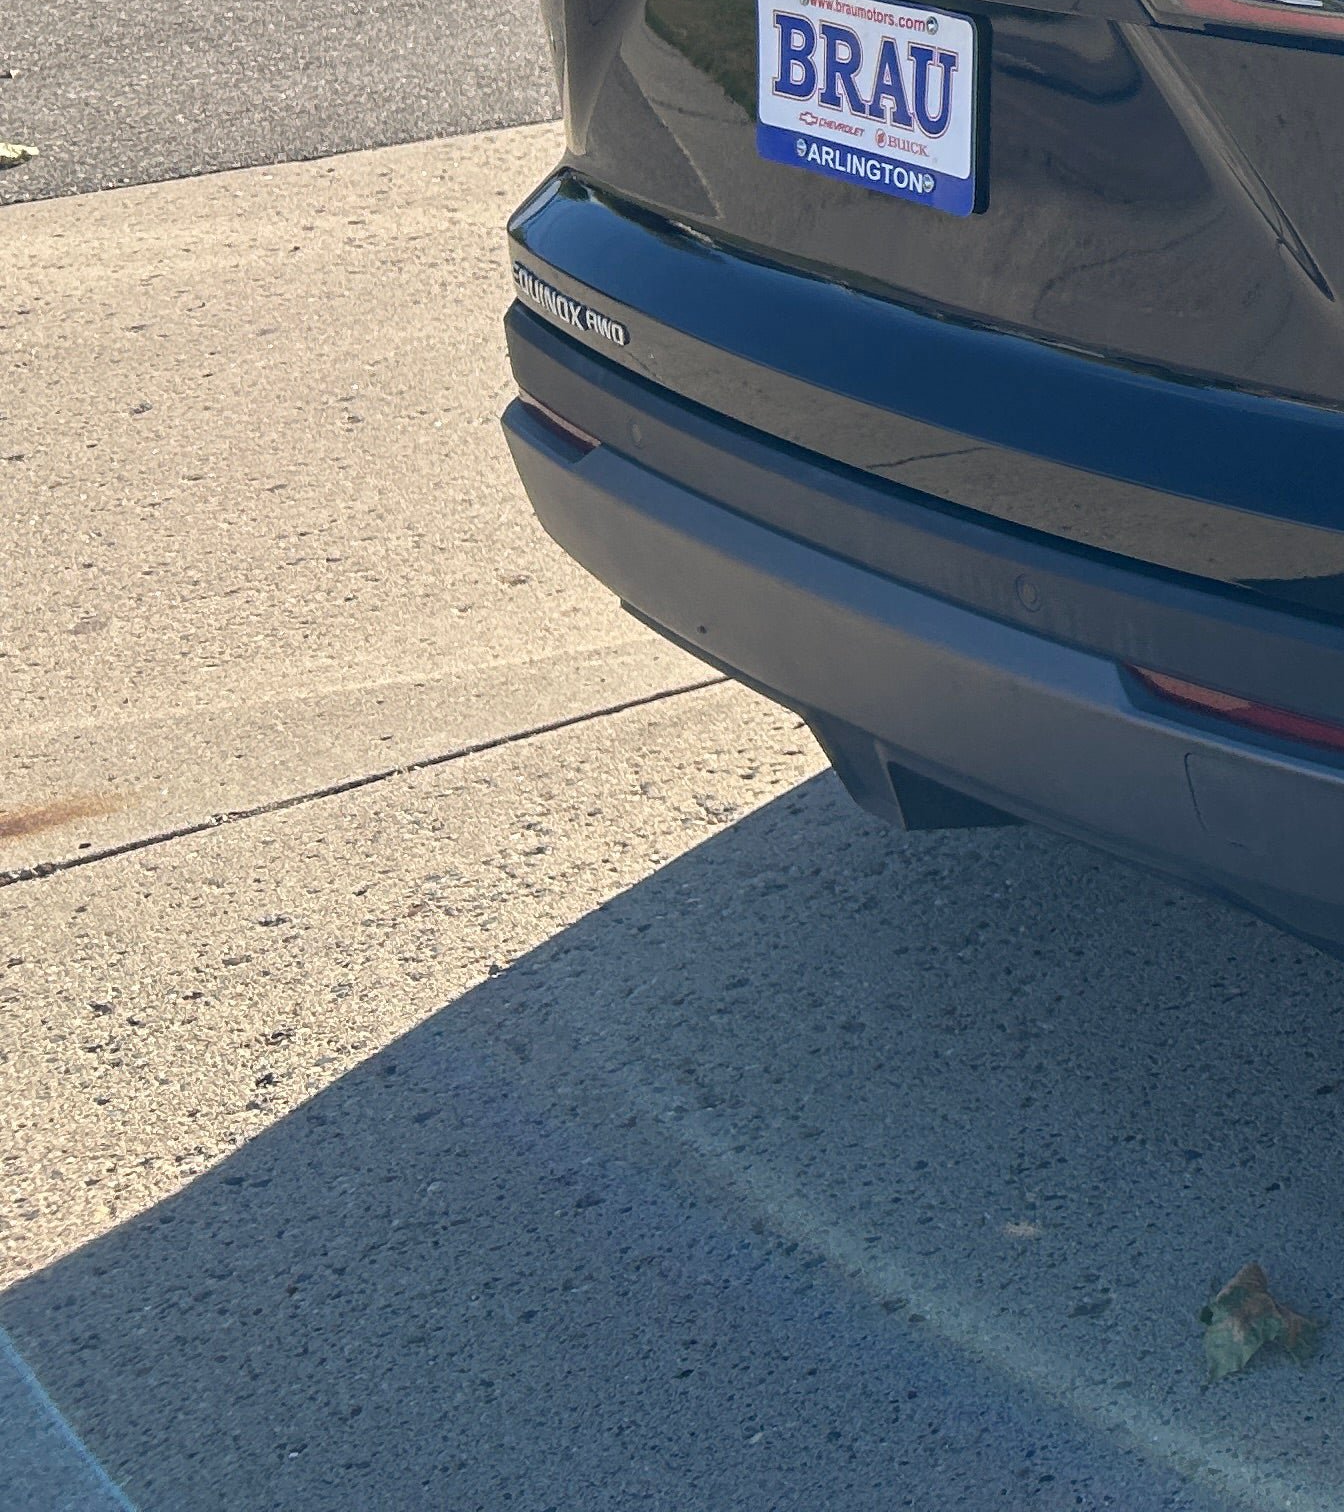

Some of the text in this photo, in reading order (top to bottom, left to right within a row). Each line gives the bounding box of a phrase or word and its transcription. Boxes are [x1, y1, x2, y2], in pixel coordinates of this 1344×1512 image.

[772, 9, 958, 139] BRAU
[819, 116, 929, 157] CHEVROLET BUICK
[807, 142, 924, 194] ARLINGTON
